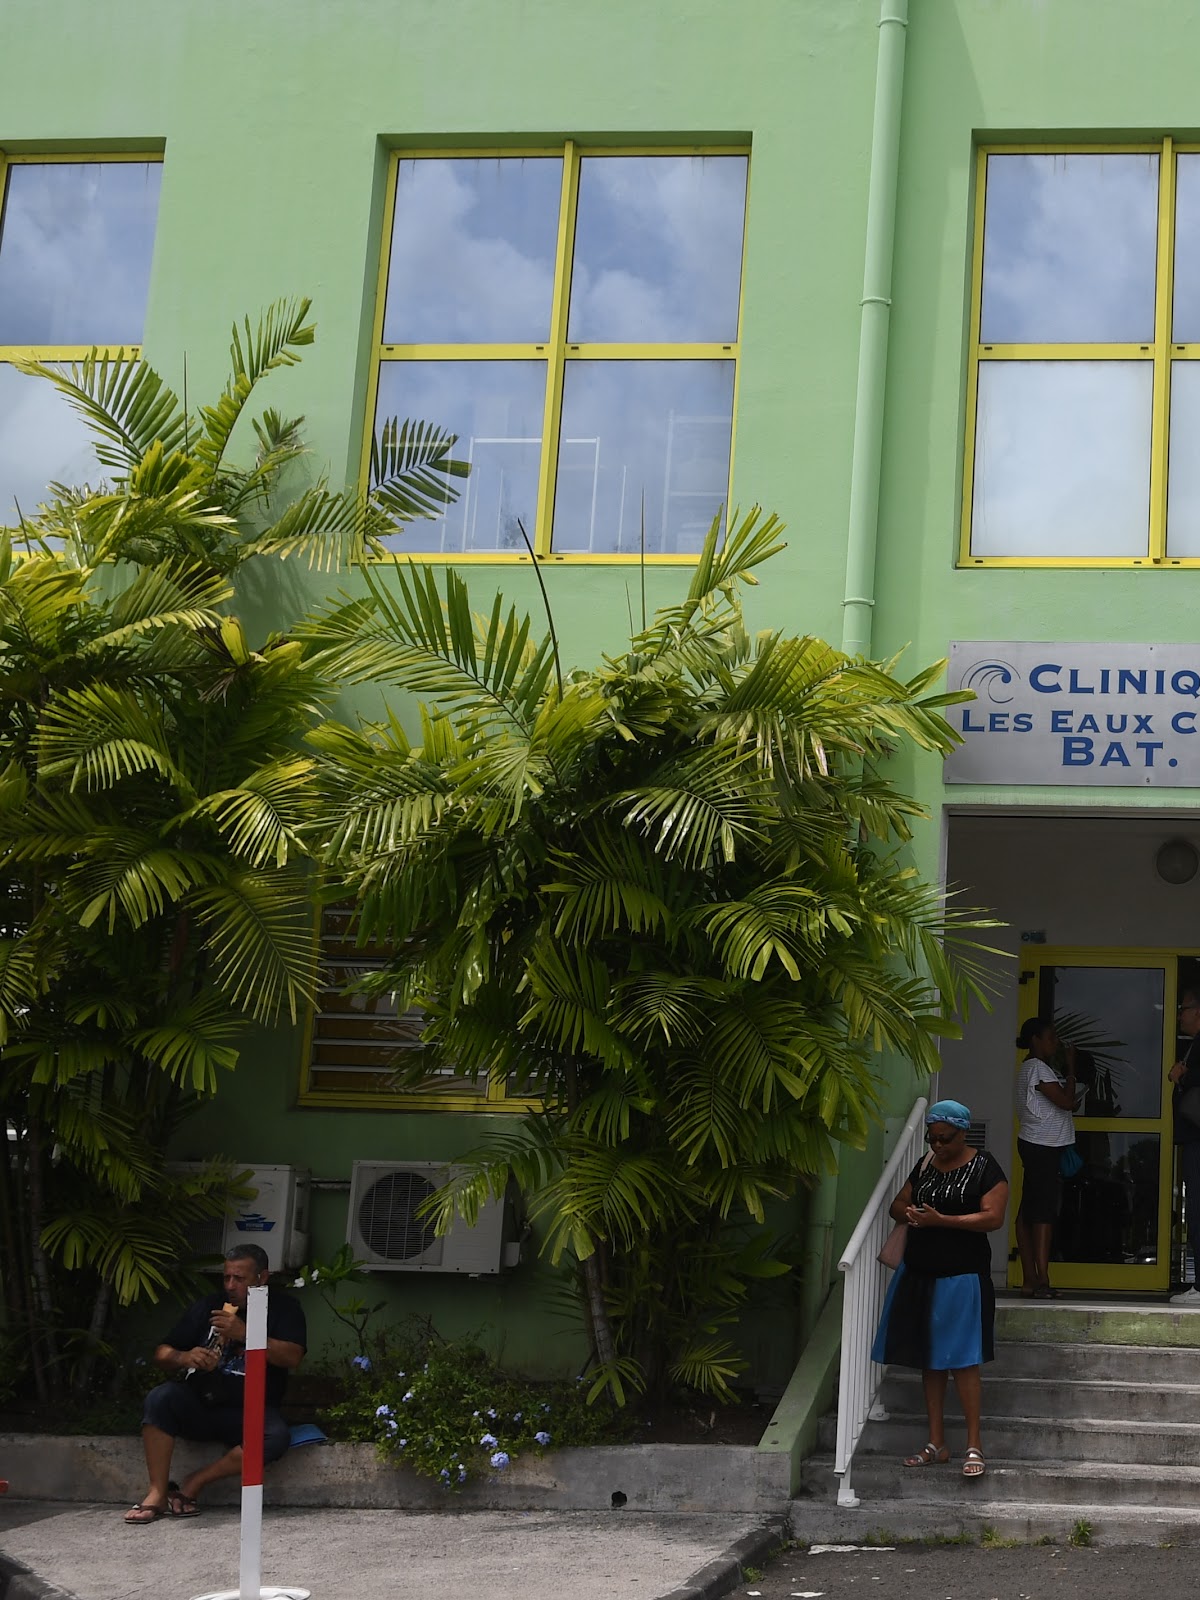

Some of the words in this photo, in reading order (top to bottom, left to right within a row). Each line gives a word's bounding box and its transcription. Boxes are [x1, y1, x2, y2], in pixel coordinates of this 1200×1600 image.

[961, 709, 1033, 733] LES
[1050, 710, 1154, 734] EAUX
[1062, 737, 1177, 767] BAT.
